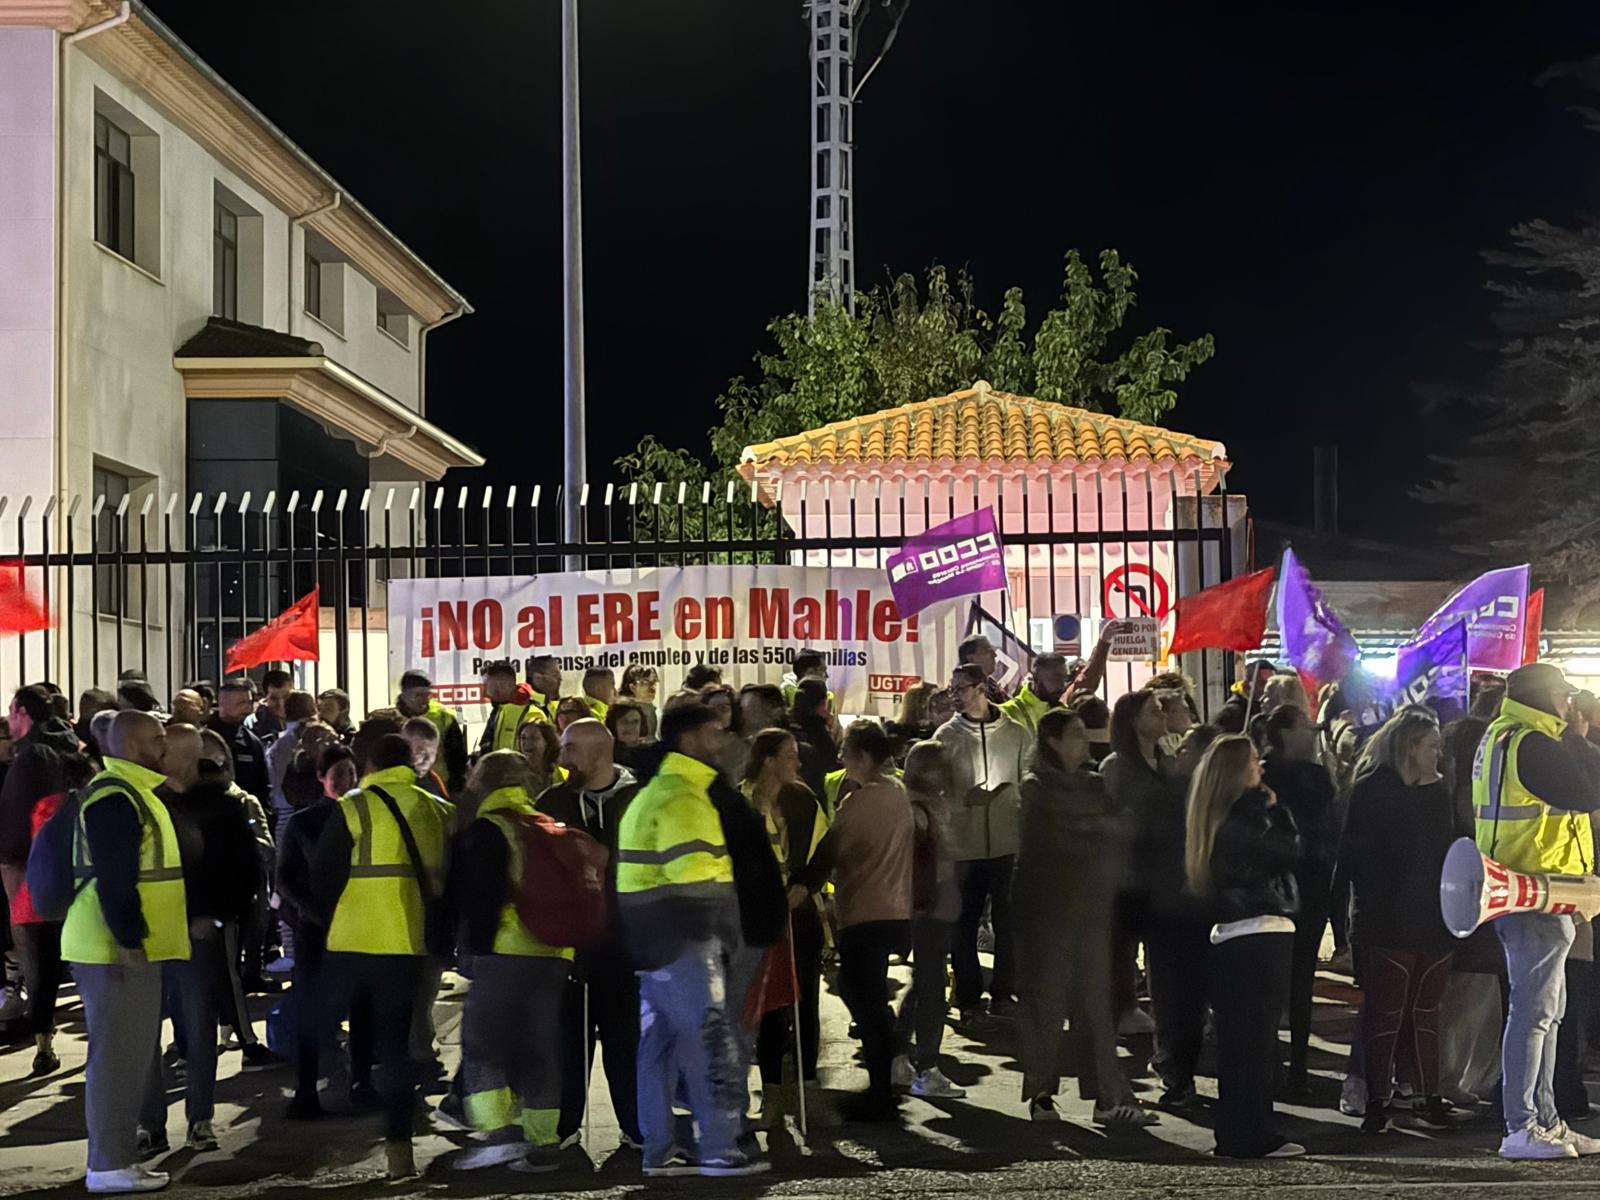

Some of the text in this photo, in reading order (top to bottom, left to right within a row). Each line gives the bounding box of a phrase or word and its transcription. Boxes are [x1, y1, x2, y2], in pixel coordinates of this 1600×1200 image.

[517, 595, 563, 648] al
[577, 591, 661, 645] ERE
[674, 596, 734, 641] en
[748, 588, 919, 643] Mahle!
[1114, 635, 1146, 643] HUELGA
[598, 650, 625, 668] del
[629, 648, 690, 668] empleo
[709, 647, 729, 665] de
[733, 647, 759, 664] las
[763, 647, 795, 665] 550
[1113, 647, 1148, 655] GENERAL
[870, 676, 904, 691] UGT
